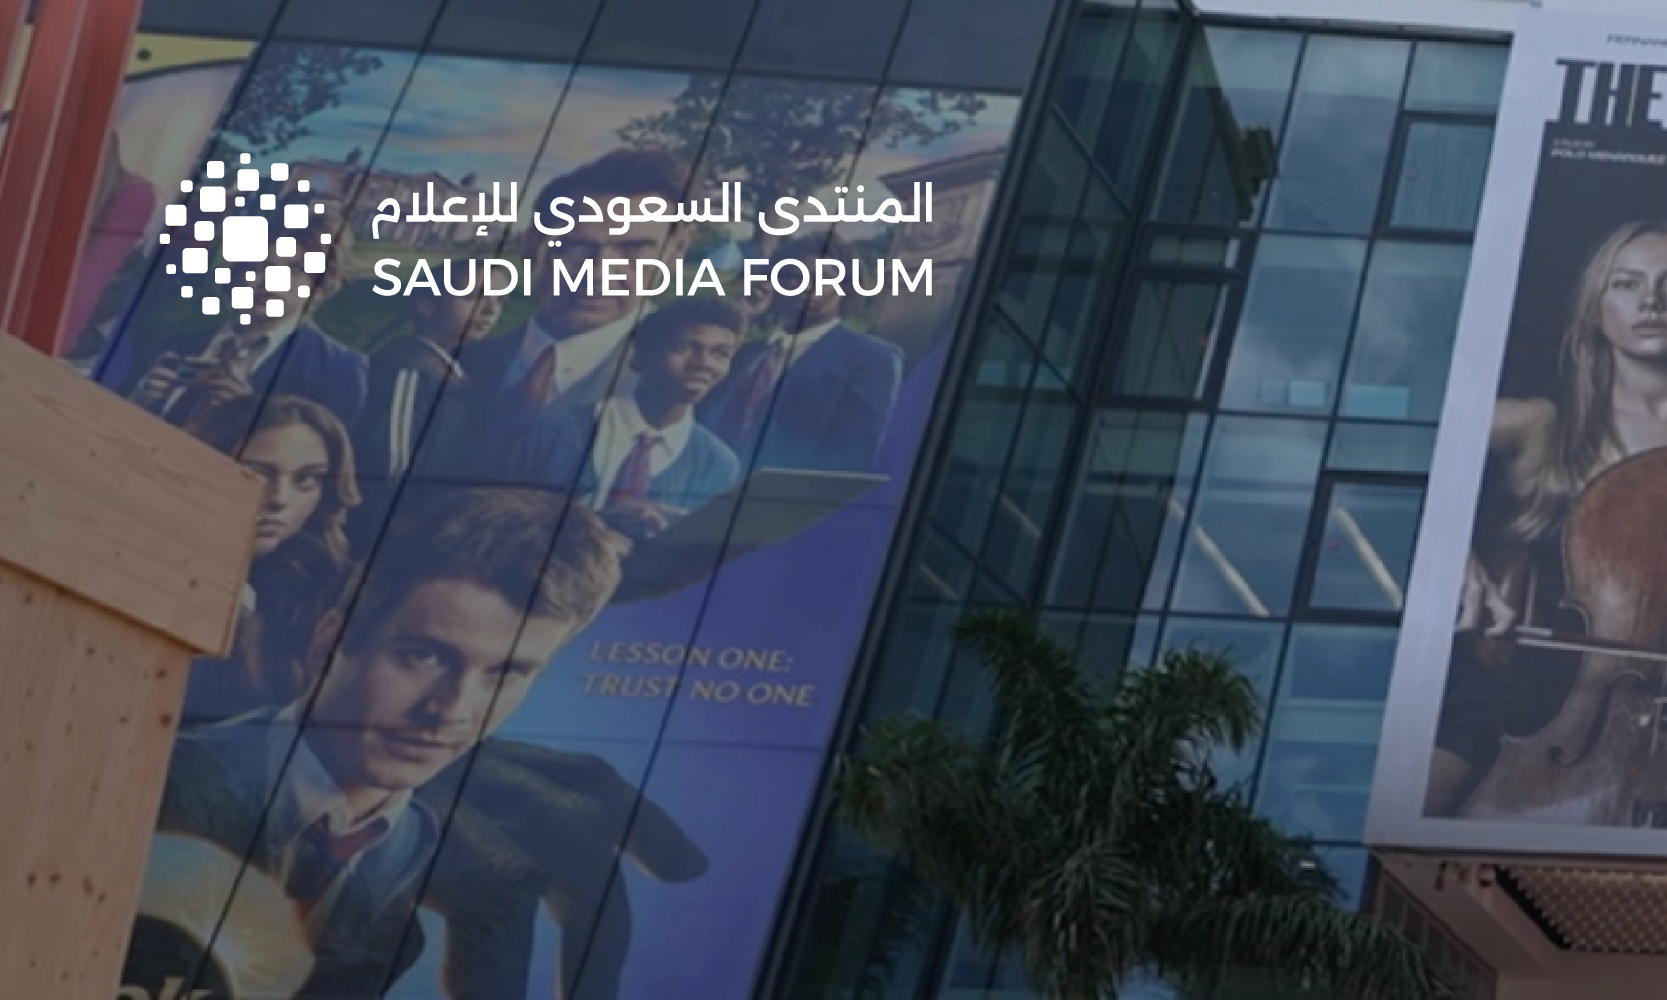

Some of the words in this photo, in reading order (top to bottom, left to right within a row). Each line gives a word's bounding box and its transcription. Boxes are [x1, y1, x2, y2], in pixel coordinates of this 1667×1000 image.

[589, 640, 713, 669] LESSON
[717, 647, 798, 674] ONE:
[582, 673, 682, 698] TRUST
[689, 680, 741, 704] NO
[745, 682, 819, 707] ONE
